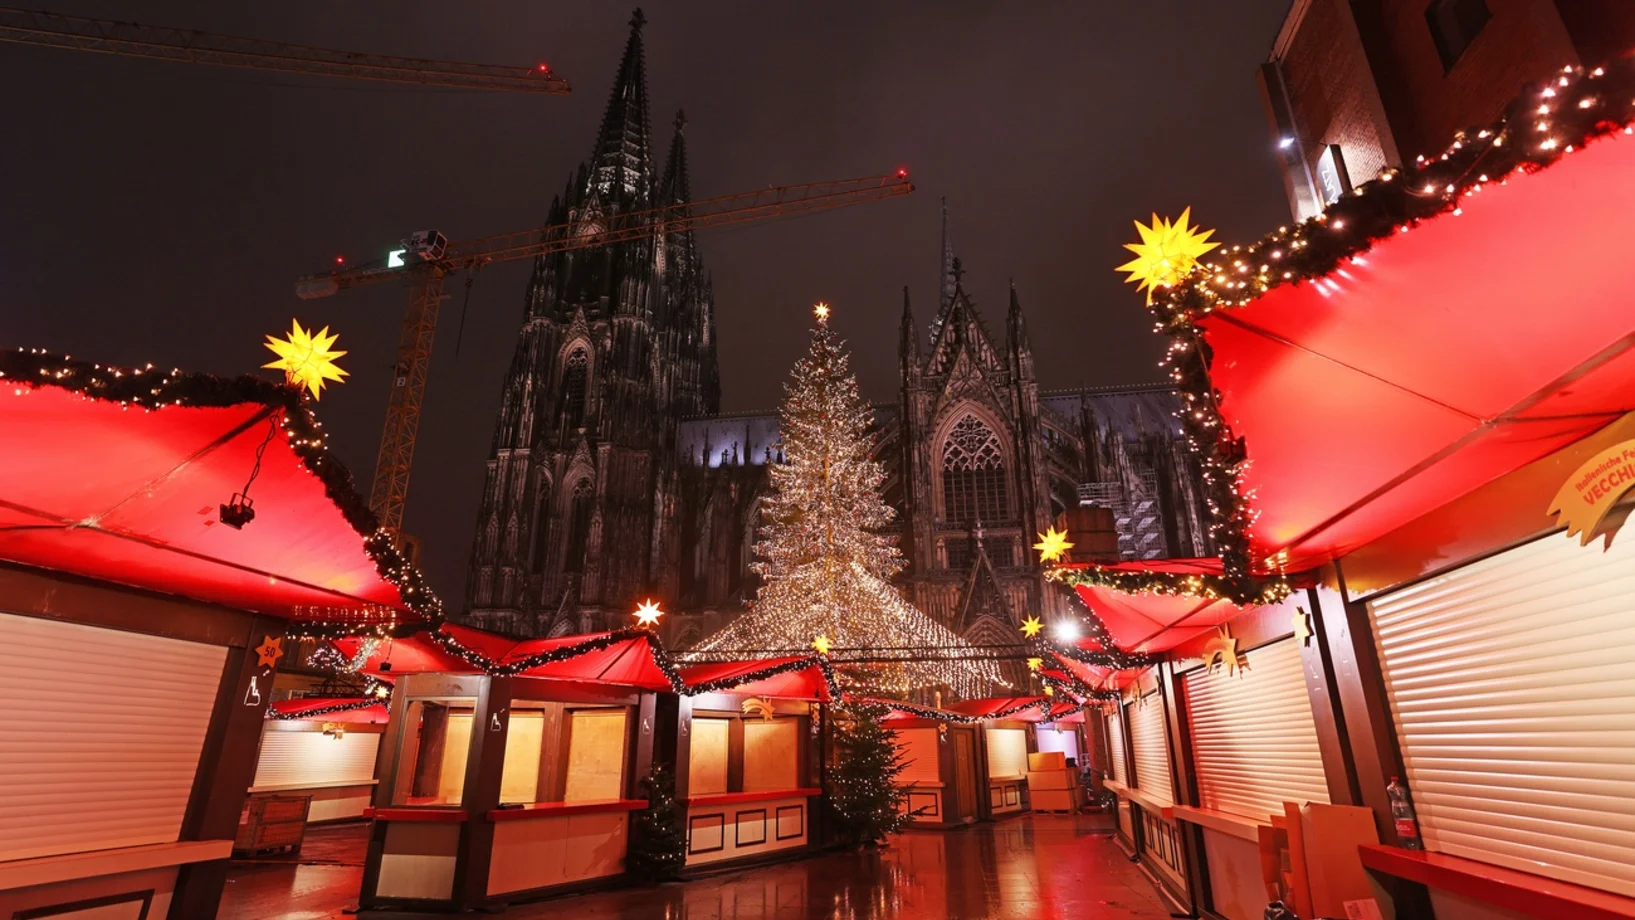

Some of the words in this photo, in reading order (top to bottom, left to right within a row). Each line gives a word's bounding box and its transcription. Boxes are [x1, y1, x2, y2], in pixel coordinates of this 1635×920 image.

[1622, 449, 1635, 461] Fe
[1583, 463, 1635, 505] VECCHI
[264, 646, 276, 658] 50
